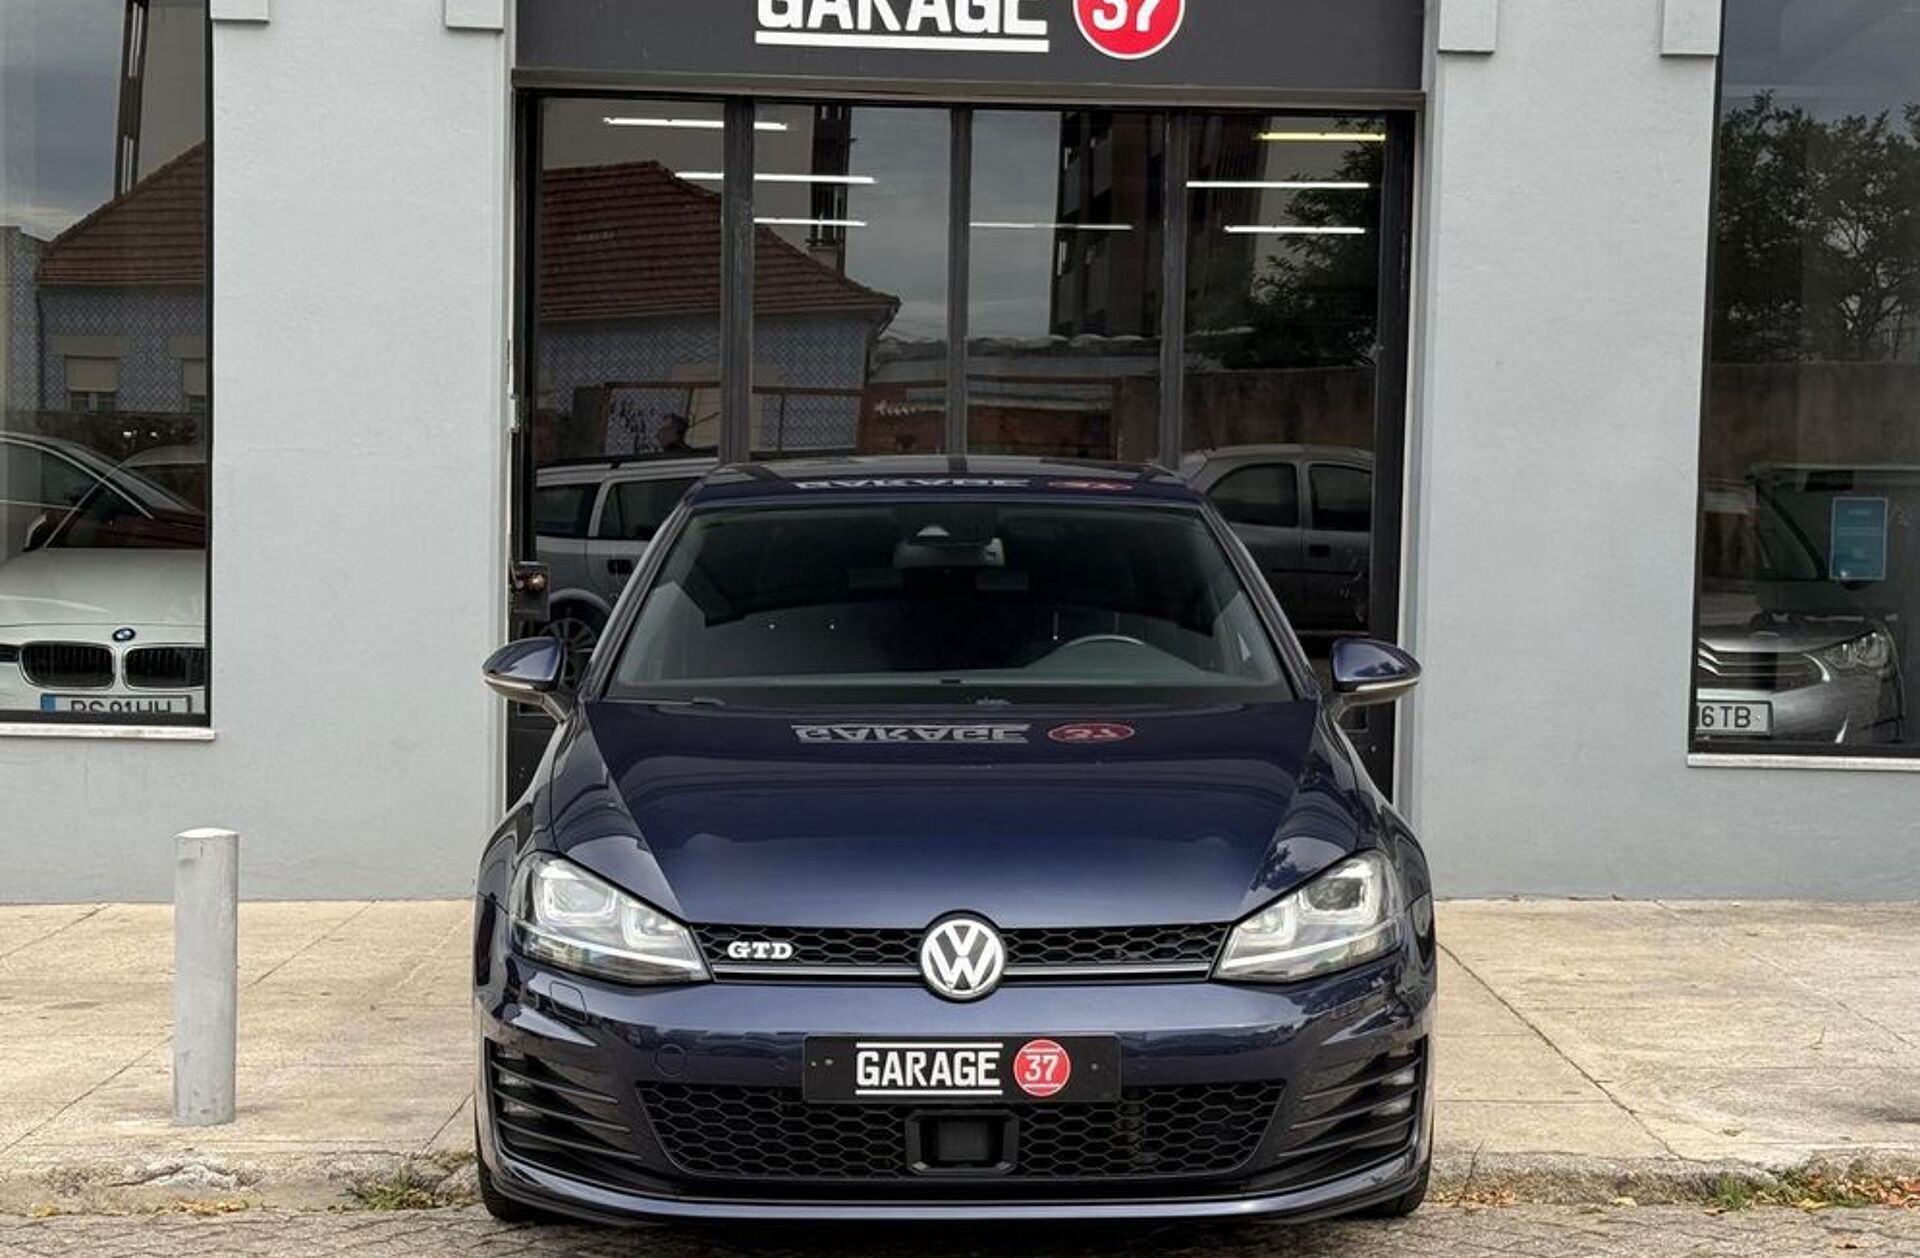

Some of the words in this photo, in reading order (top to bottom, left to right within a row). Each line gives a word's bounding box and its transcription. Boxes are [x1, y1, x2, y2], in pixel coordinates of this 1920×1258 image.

[1696, 706, 1714, 728] 6
[1720, 706, 1751, 728] TB
[727, 941, 793, 959] GTD
[856, 1051, 1000, 1087] GARAGE
[1024, 1054, 1058, 1081] 37
